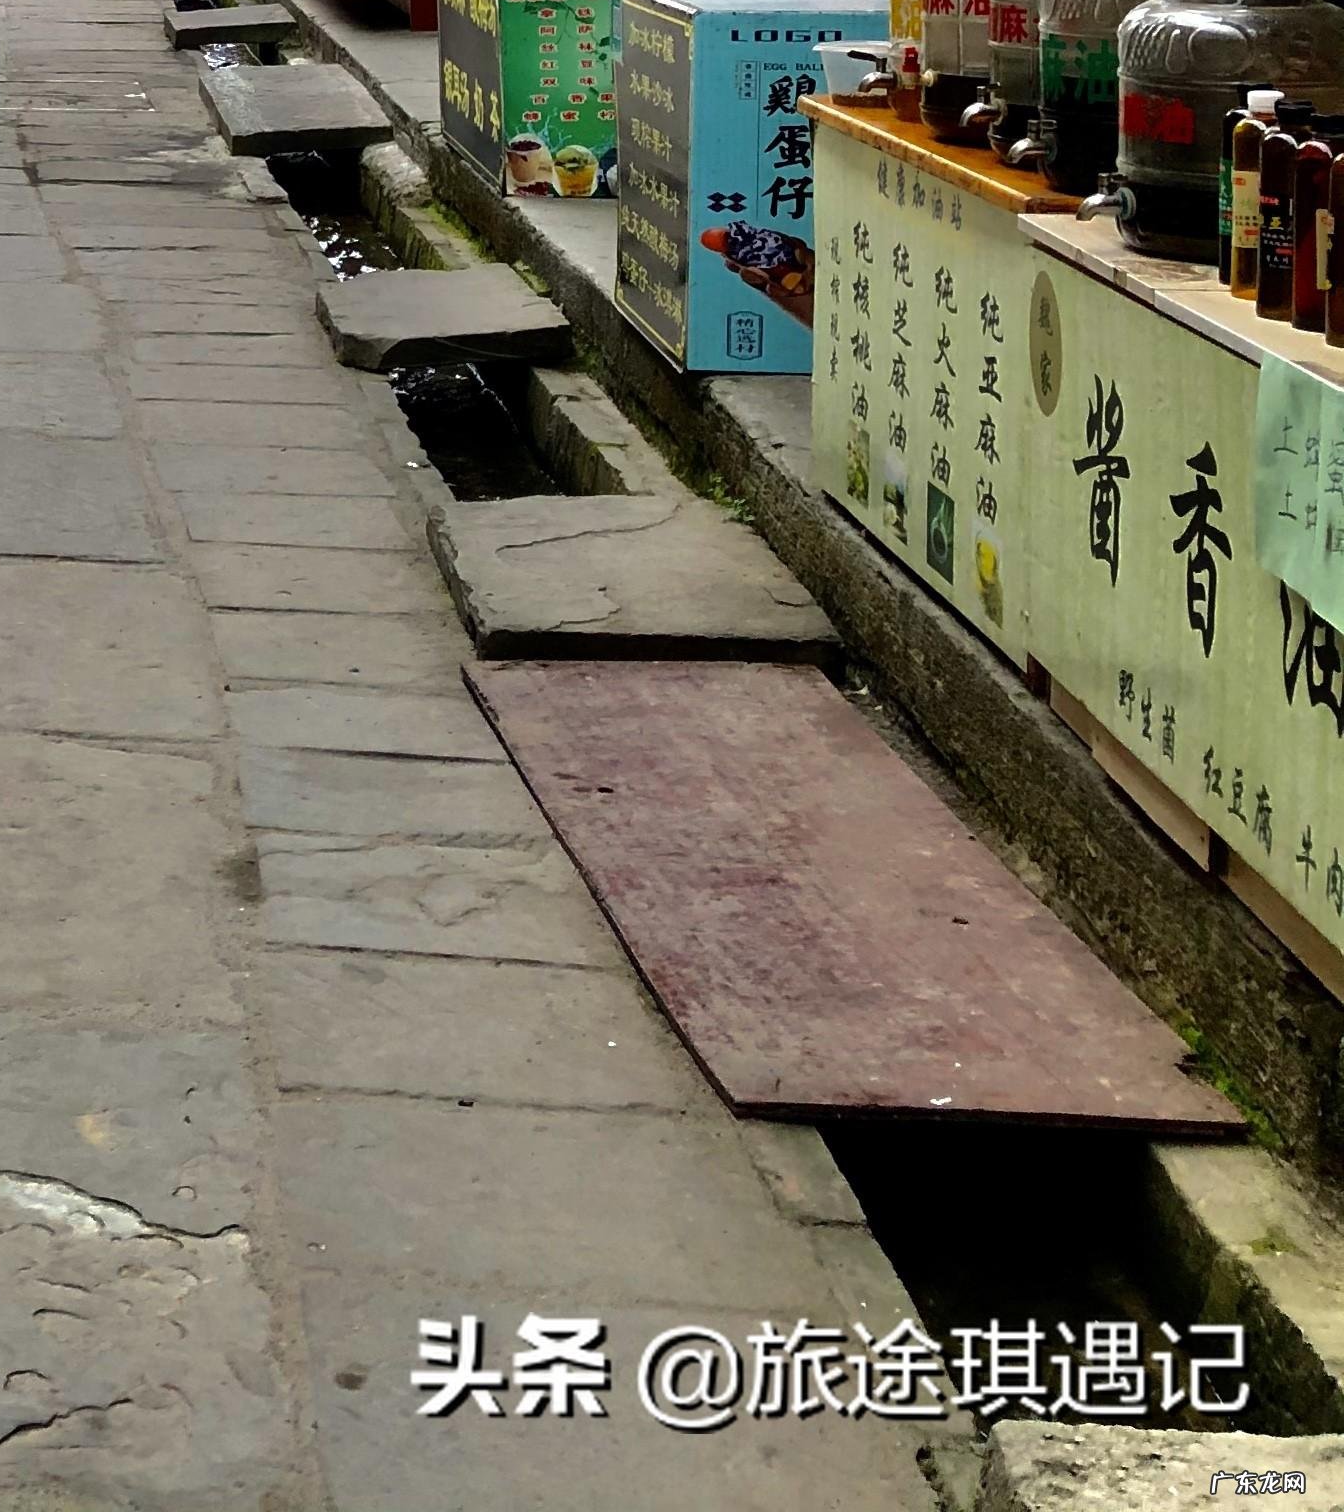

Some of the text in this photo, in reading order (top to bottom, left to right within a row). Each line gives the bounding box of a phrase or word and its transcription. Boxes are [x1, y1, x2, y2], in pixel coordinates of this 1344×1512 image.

[731, 29, 842, 43] LOGO
[763, 62, 788, 71] EGG
[877, 159, 963, 231] 健康加油站
[851, 221, 874, 423] 纯核桃油
[888, 242, 914, 454] 纯芝麻油
[929, 265, 958, 488] 纯火麻油
[974, 291, 1004, 526] 纯亚麻油
